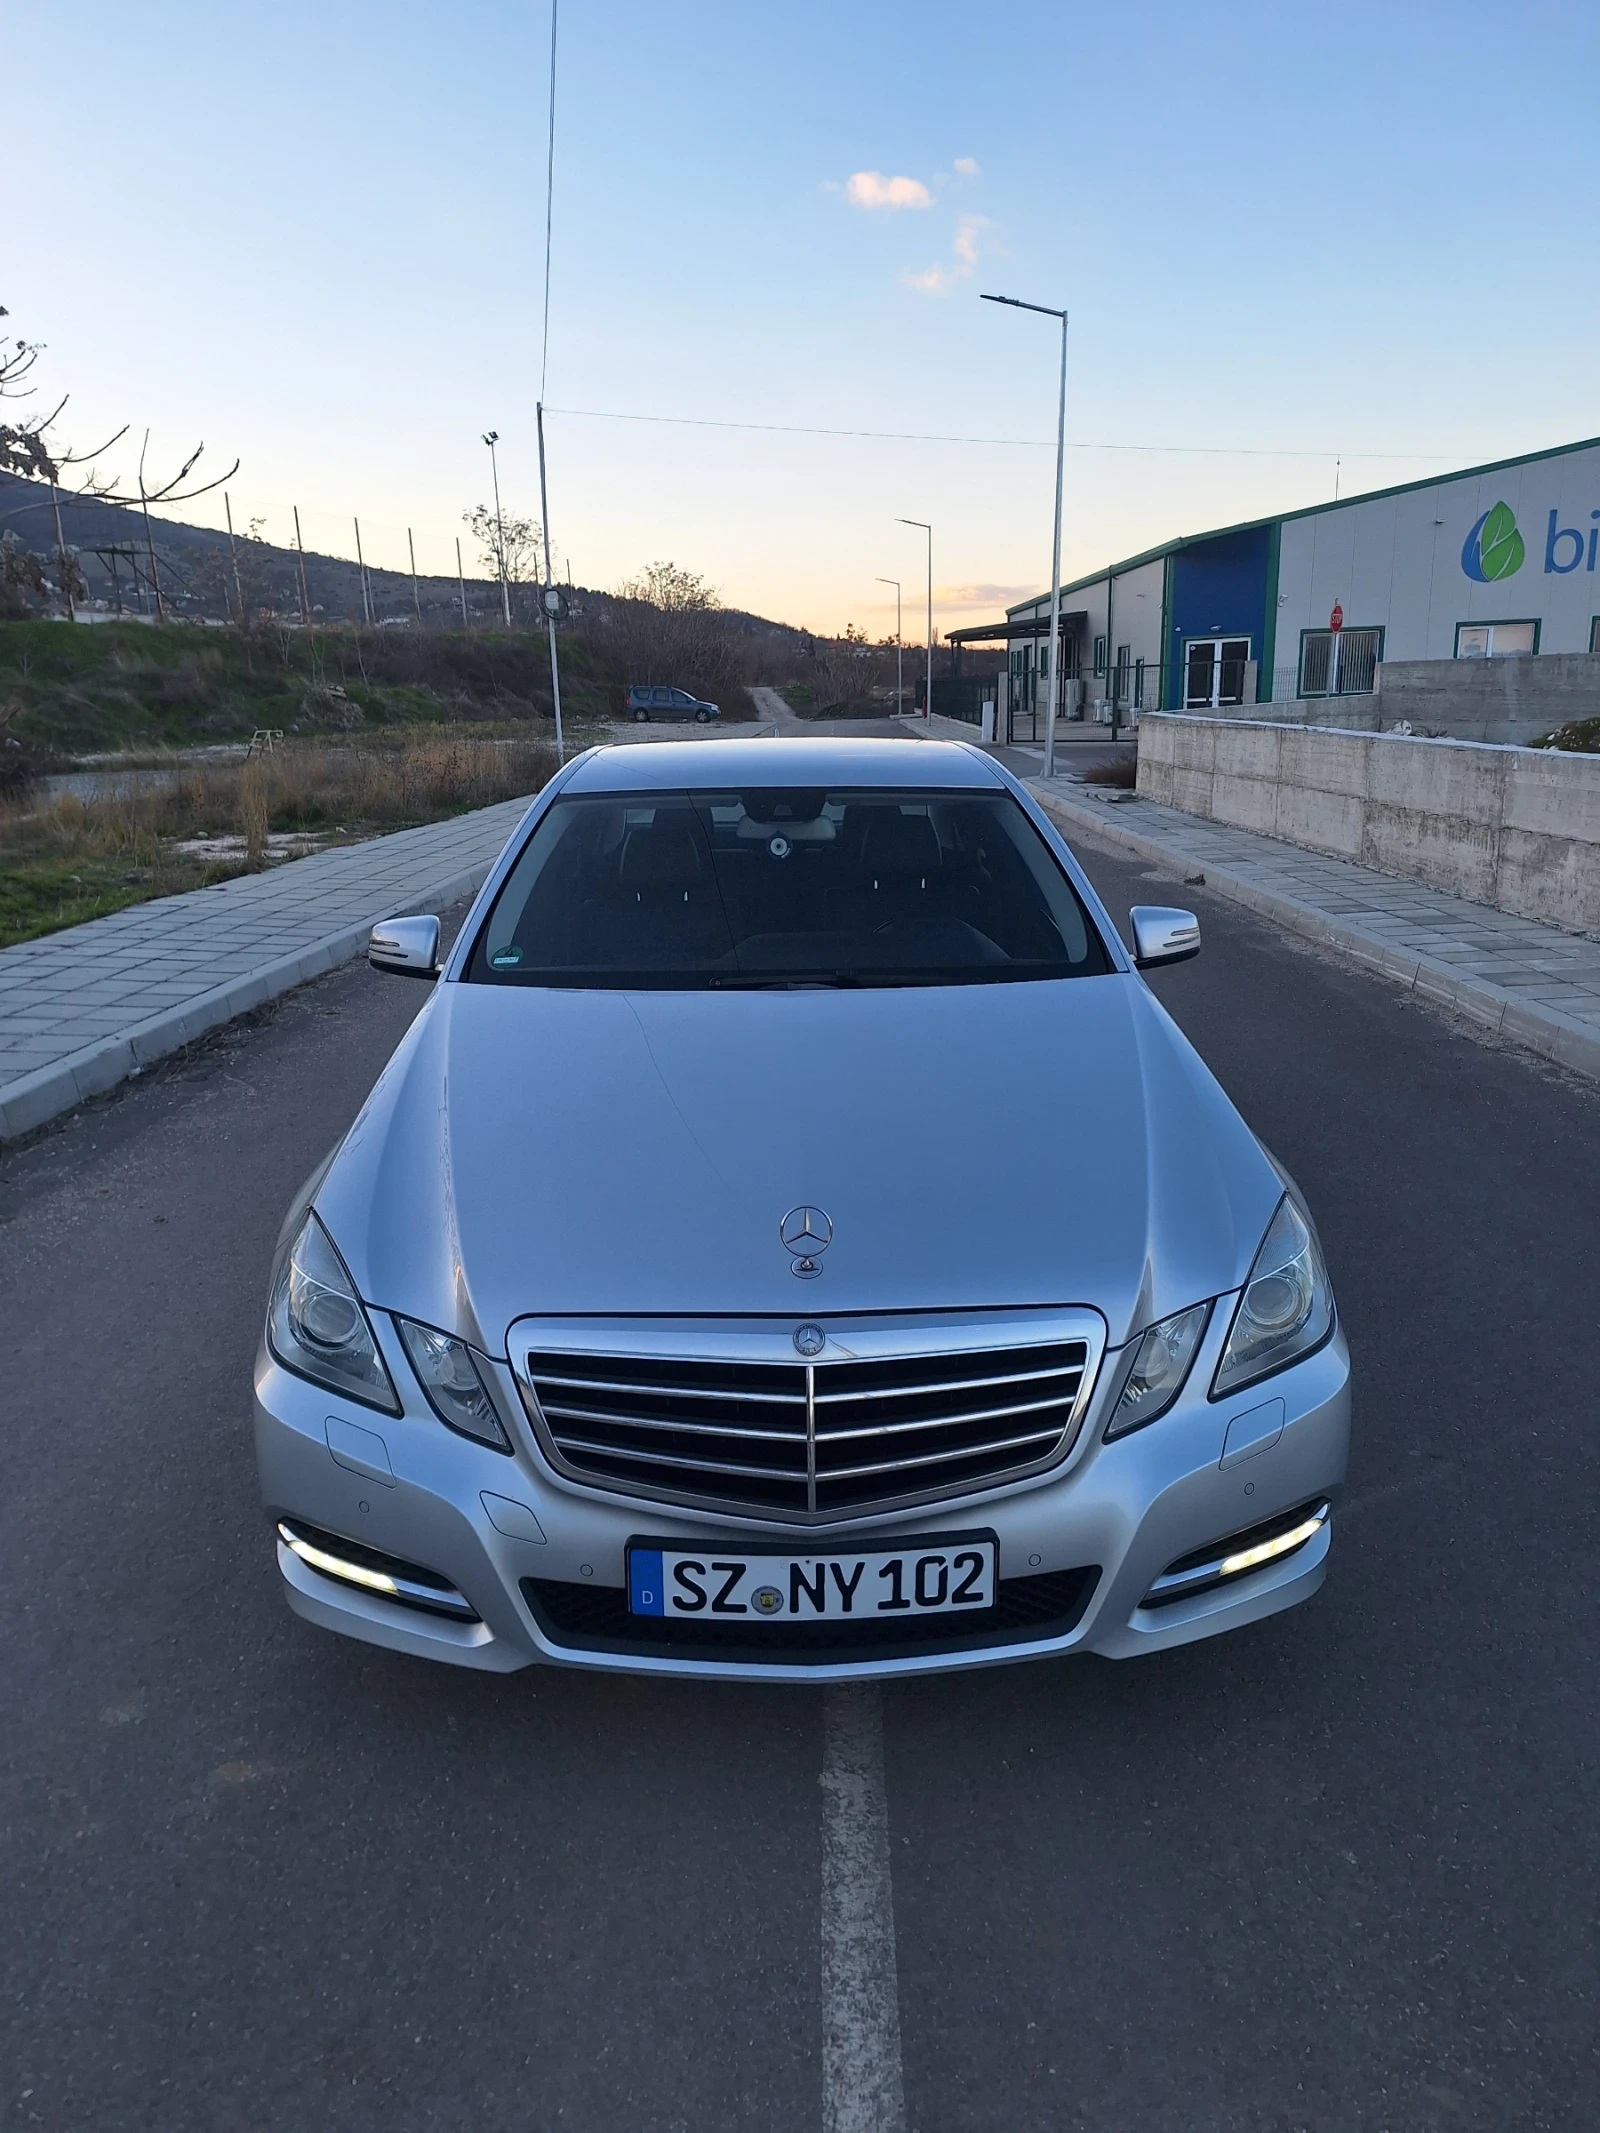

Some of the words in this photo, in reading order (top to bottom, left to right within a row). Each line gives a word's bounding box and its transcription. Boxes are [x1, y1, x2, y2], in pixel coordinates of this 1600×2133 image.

[1331, 613, 1342, 625] STOP
[642, 1591, 653, 1605] D
[672, 1560, 748, 1614] SZ
[789, 1561, 866, 1614] NY
[877, 1551, 985, 1610] 102
